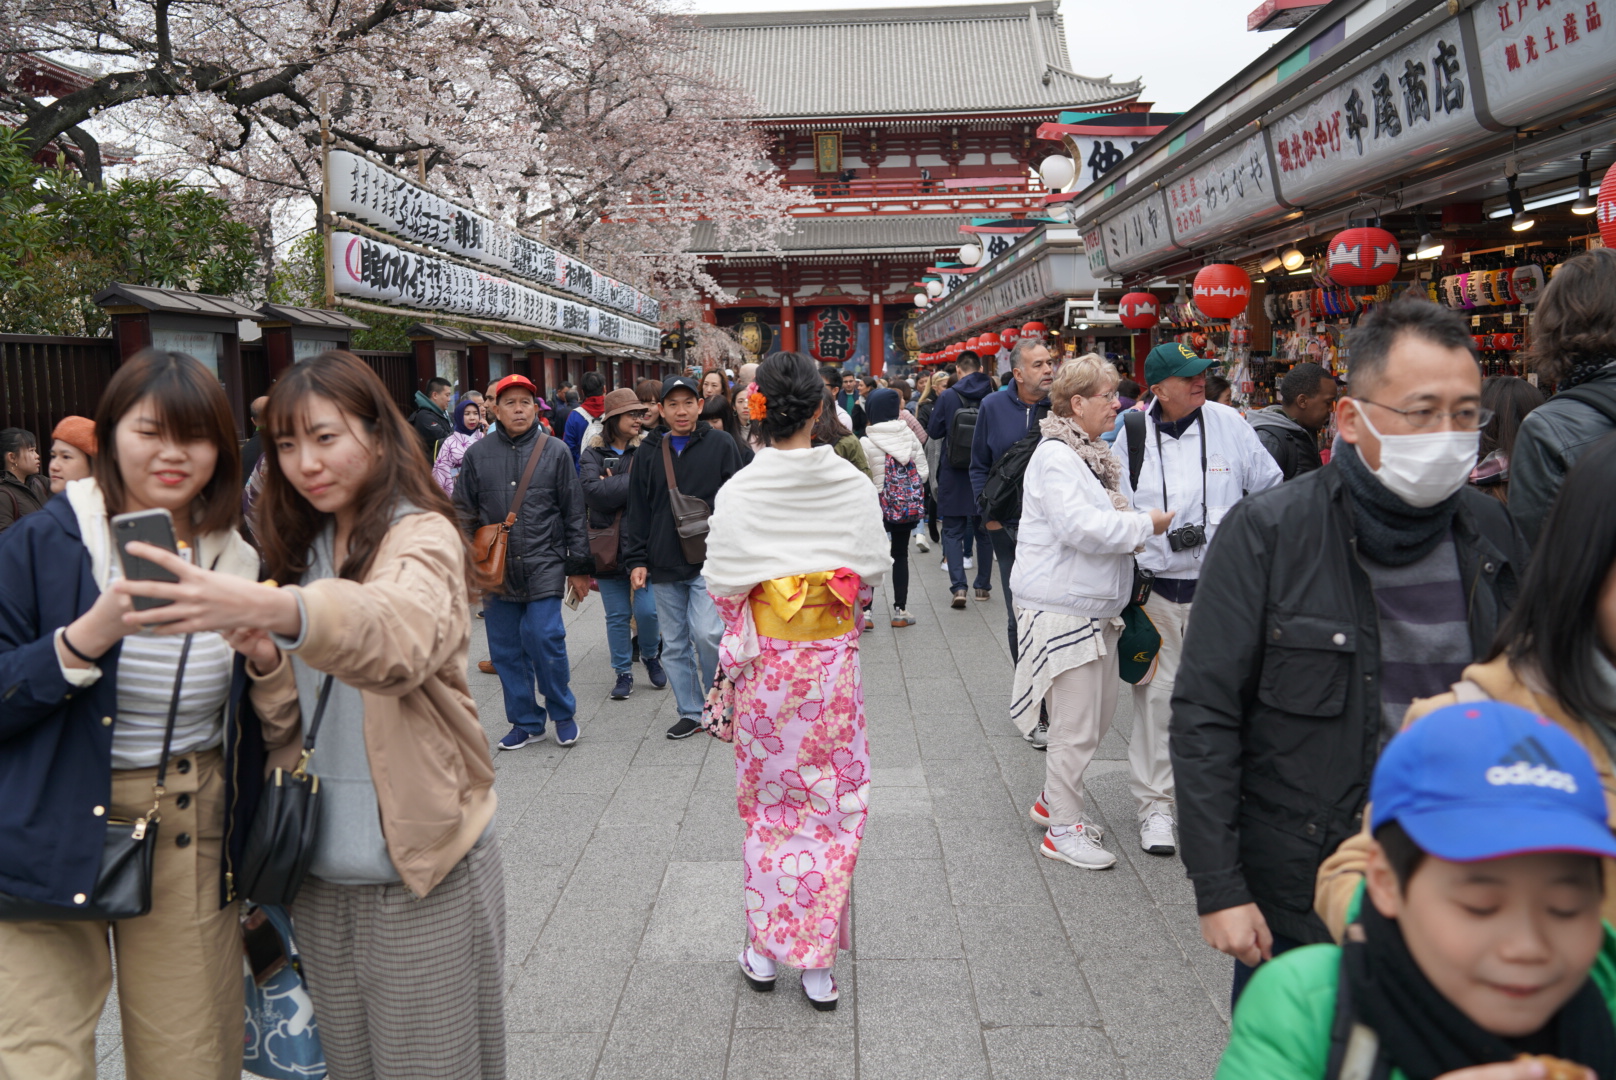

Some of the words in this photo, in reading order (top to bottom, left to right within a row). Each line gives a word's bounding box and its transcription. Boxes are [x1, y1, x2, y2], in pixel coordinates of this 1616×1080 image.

[1505, 1, 1602, 72] 観光土産品
[1344, 39, 1464, 156] 平尾商店
[1277, 110, 1341, 173] 観光みやげ
[1171, 177, 1198, 209] 民芸品
[1205, 151, 1263, 211] わらびや
[1110, 206, 1158, 258] ミノリヤ
[1176, 204, 1202, 233] おみやげ
[818, 305, 850, 360] 小舟町
[1486, 760, 1578, 794] adidas
